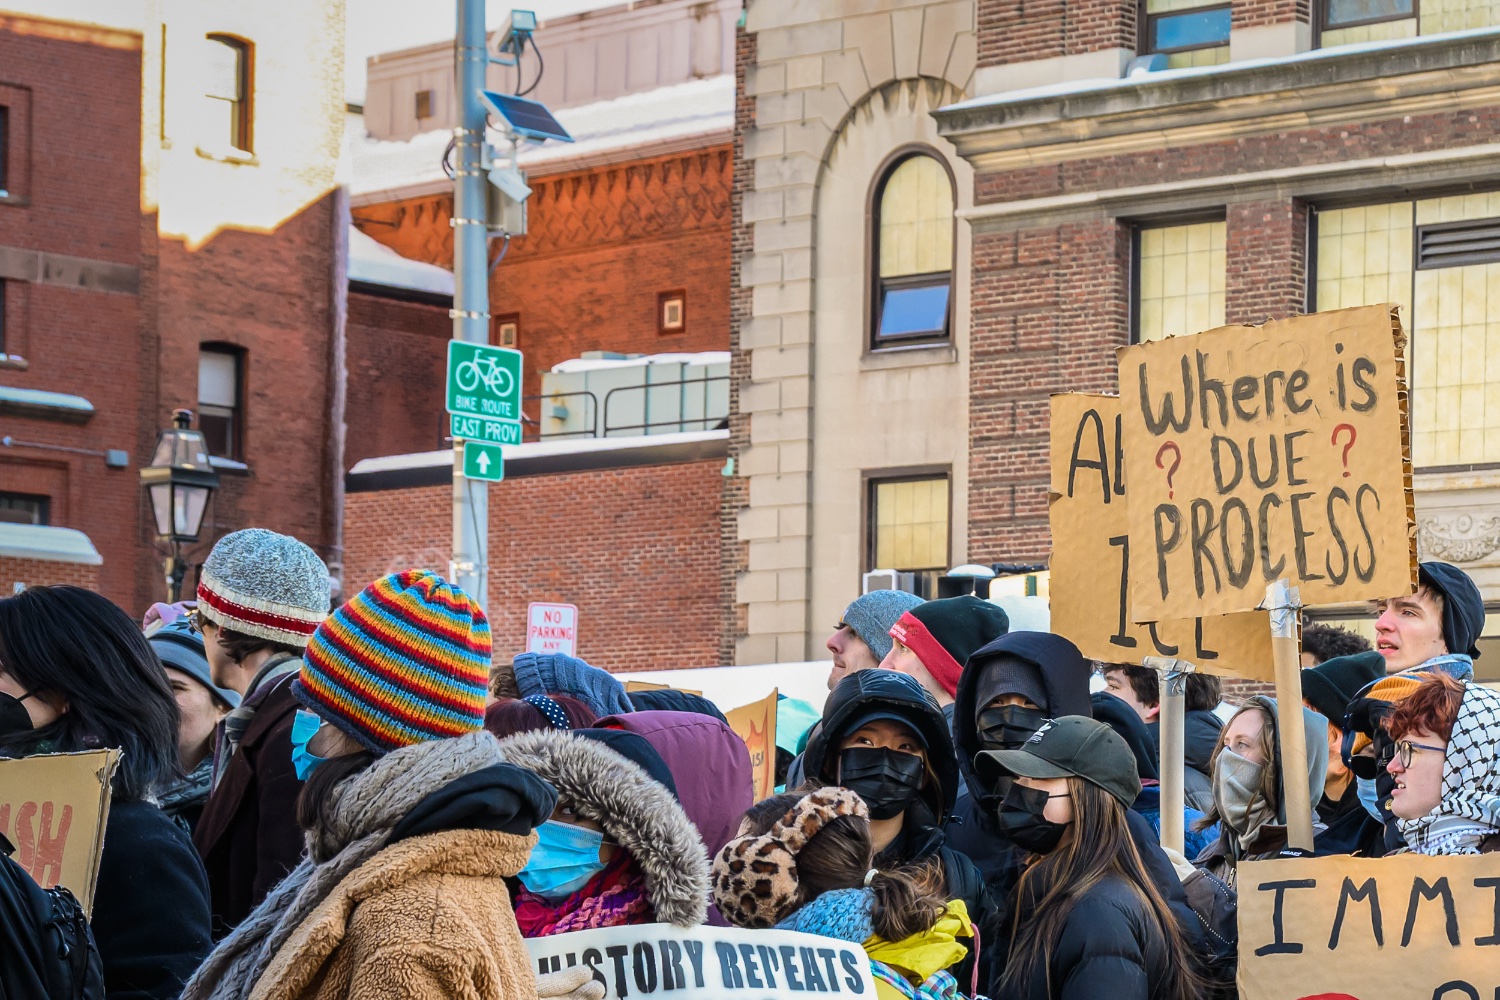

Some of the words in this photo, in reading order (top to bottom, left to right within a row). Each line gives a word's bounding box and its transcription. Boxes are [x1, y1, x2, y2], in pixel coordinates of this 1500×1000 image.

[1140, 348, 1314, 436] Where
[1335, 342, 1378, 412] is
[455, 395, 477, 411] BIKE
[481, 398, 512, 416] ROUTE
[453, 416, 480, 437] EAST
[485, 422, 518, 443] PROV
[1154, 440, 1182, 500] ?
[1210, 429, 1314, 495] DUE
[1331, 423, 1357, 478] ?
[1153, 484, 1380, 602] PROCESS
[544, 611, 562, 624] NO
[531, 626, 572, 640] PARKING
[543, 641, 560, 650] ANY
[714, 941, 864, 995] REPEATS
